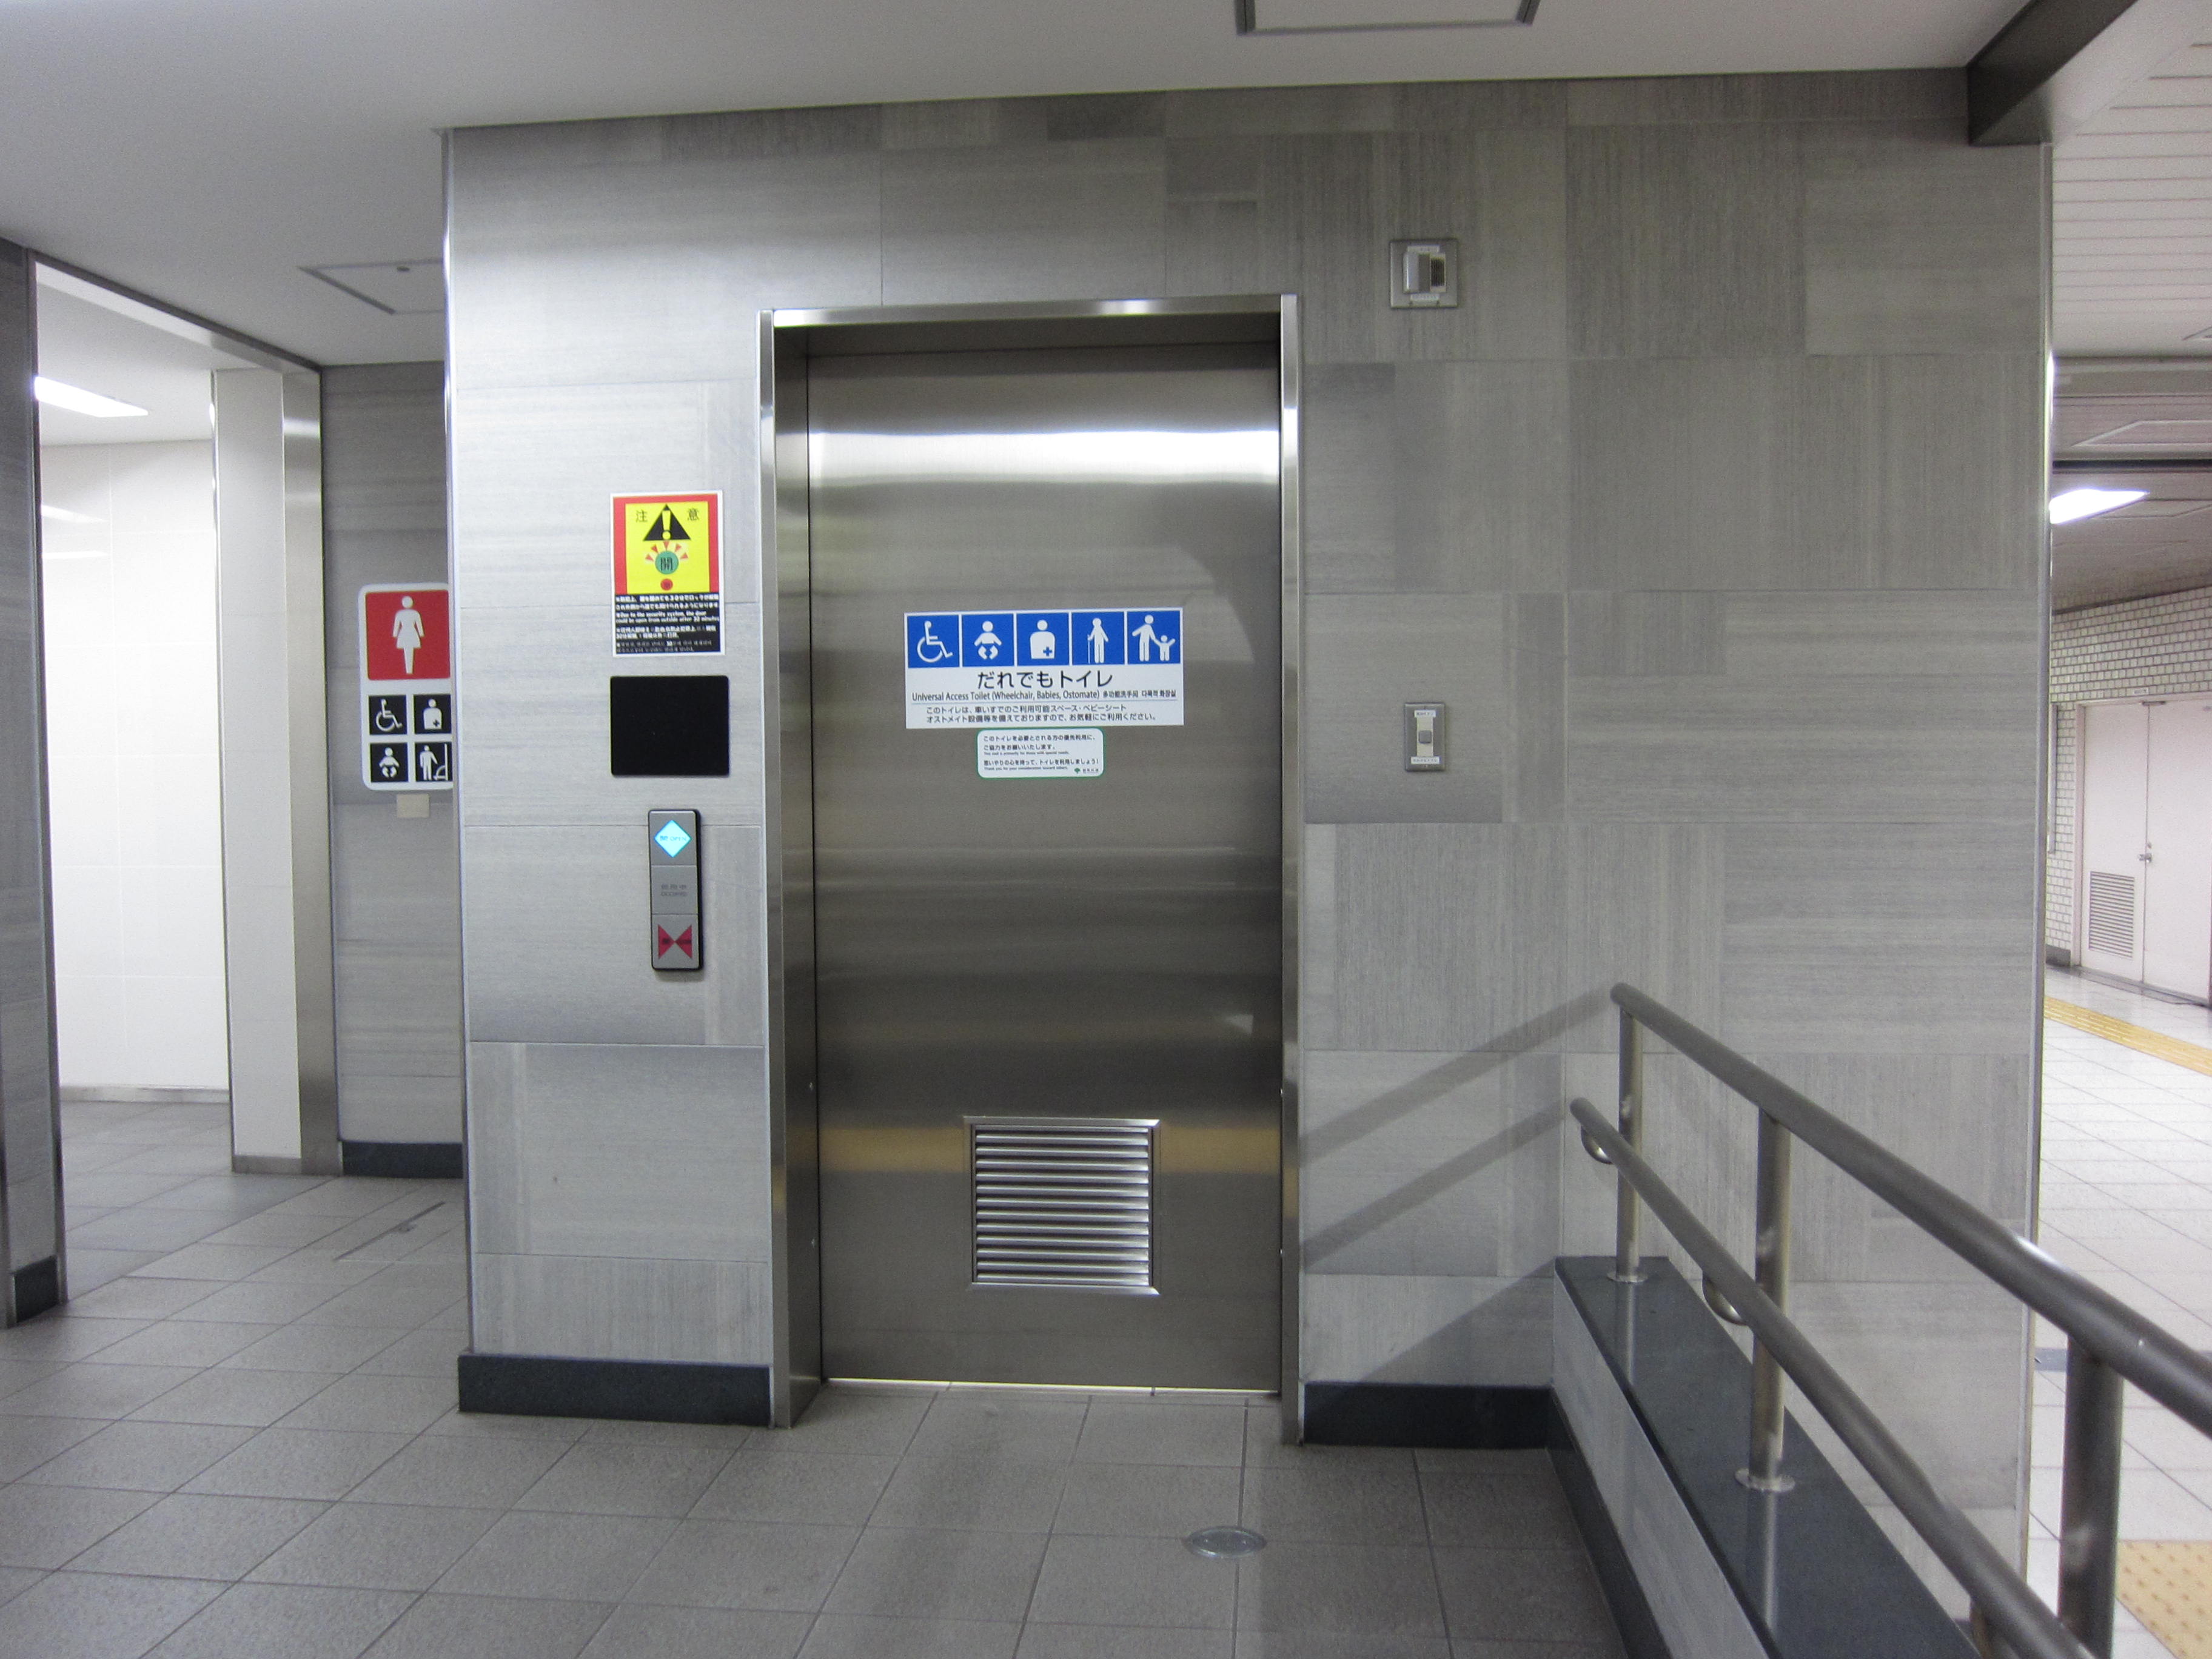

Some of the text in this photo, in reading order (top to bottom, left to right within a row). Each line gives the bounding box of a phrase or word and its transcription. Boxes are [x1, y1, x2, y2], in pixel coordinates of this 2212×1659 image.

[635, 508, 700, 523] 注 意
[977, 670, 1113, 689] だれでもトイレ
[912, 692, 944, 701] Universal
[946, 692, 968, 700] Access
[971, 691, 990, 700] Toilet
[992, 690, 1035, 701] (Wheelchair,
[1037, 690, 1061, 700] Babies,
[1063, 690, 1099, 700] Ostomate)
